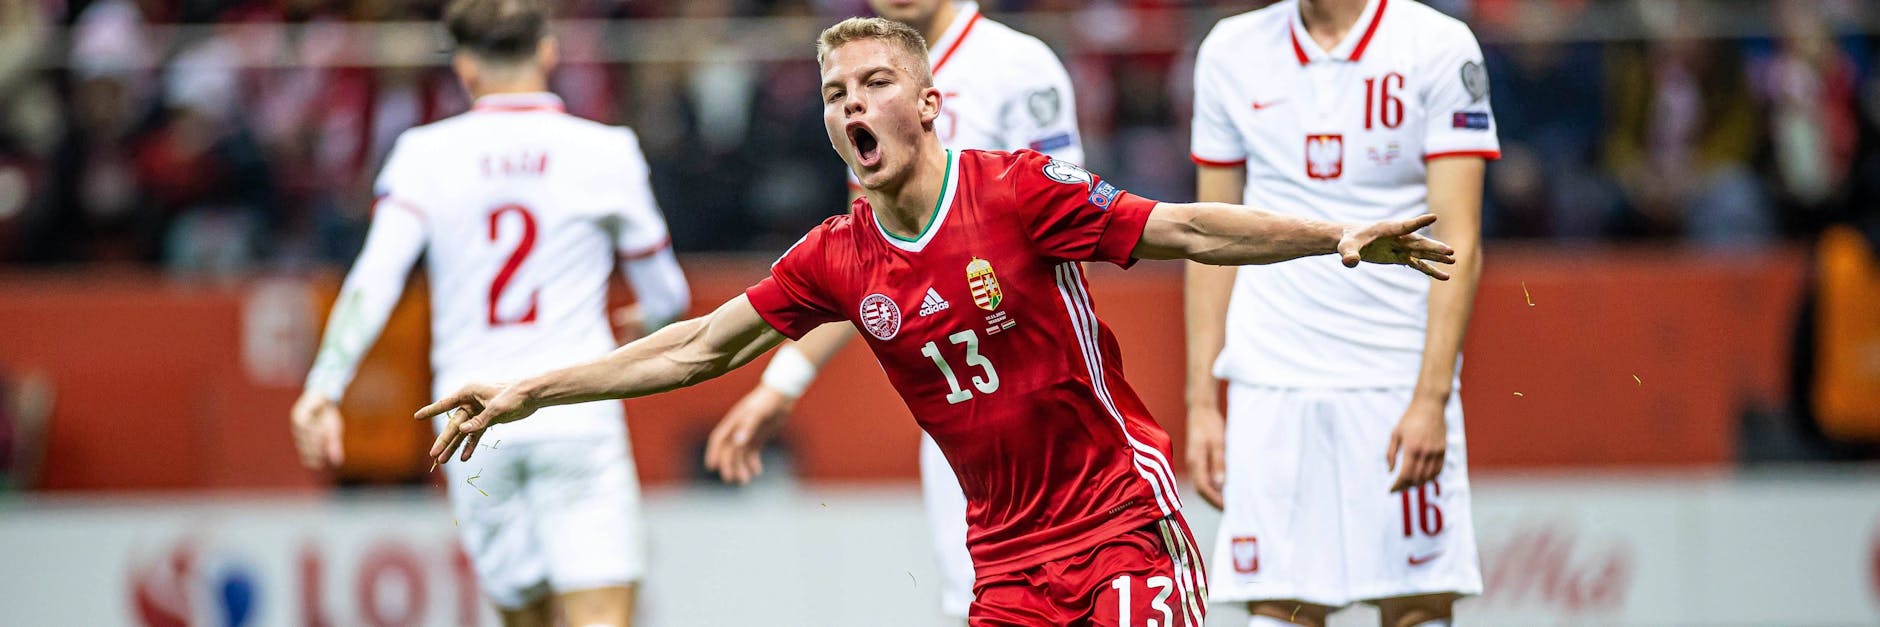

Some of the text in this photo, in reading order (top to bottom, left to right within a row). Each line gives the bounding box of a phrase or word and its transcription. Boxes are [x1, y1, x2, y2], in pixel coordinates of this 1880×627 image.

[1364, 71, 1405, 131] 16
[487, 203, 539, 327] 2
[919, 301, 950, 317] adidas
[921, 329, 999, 404] 13
[1401, 480, 1444, 537] 16
[1112, 575, 1173, 627] 13
